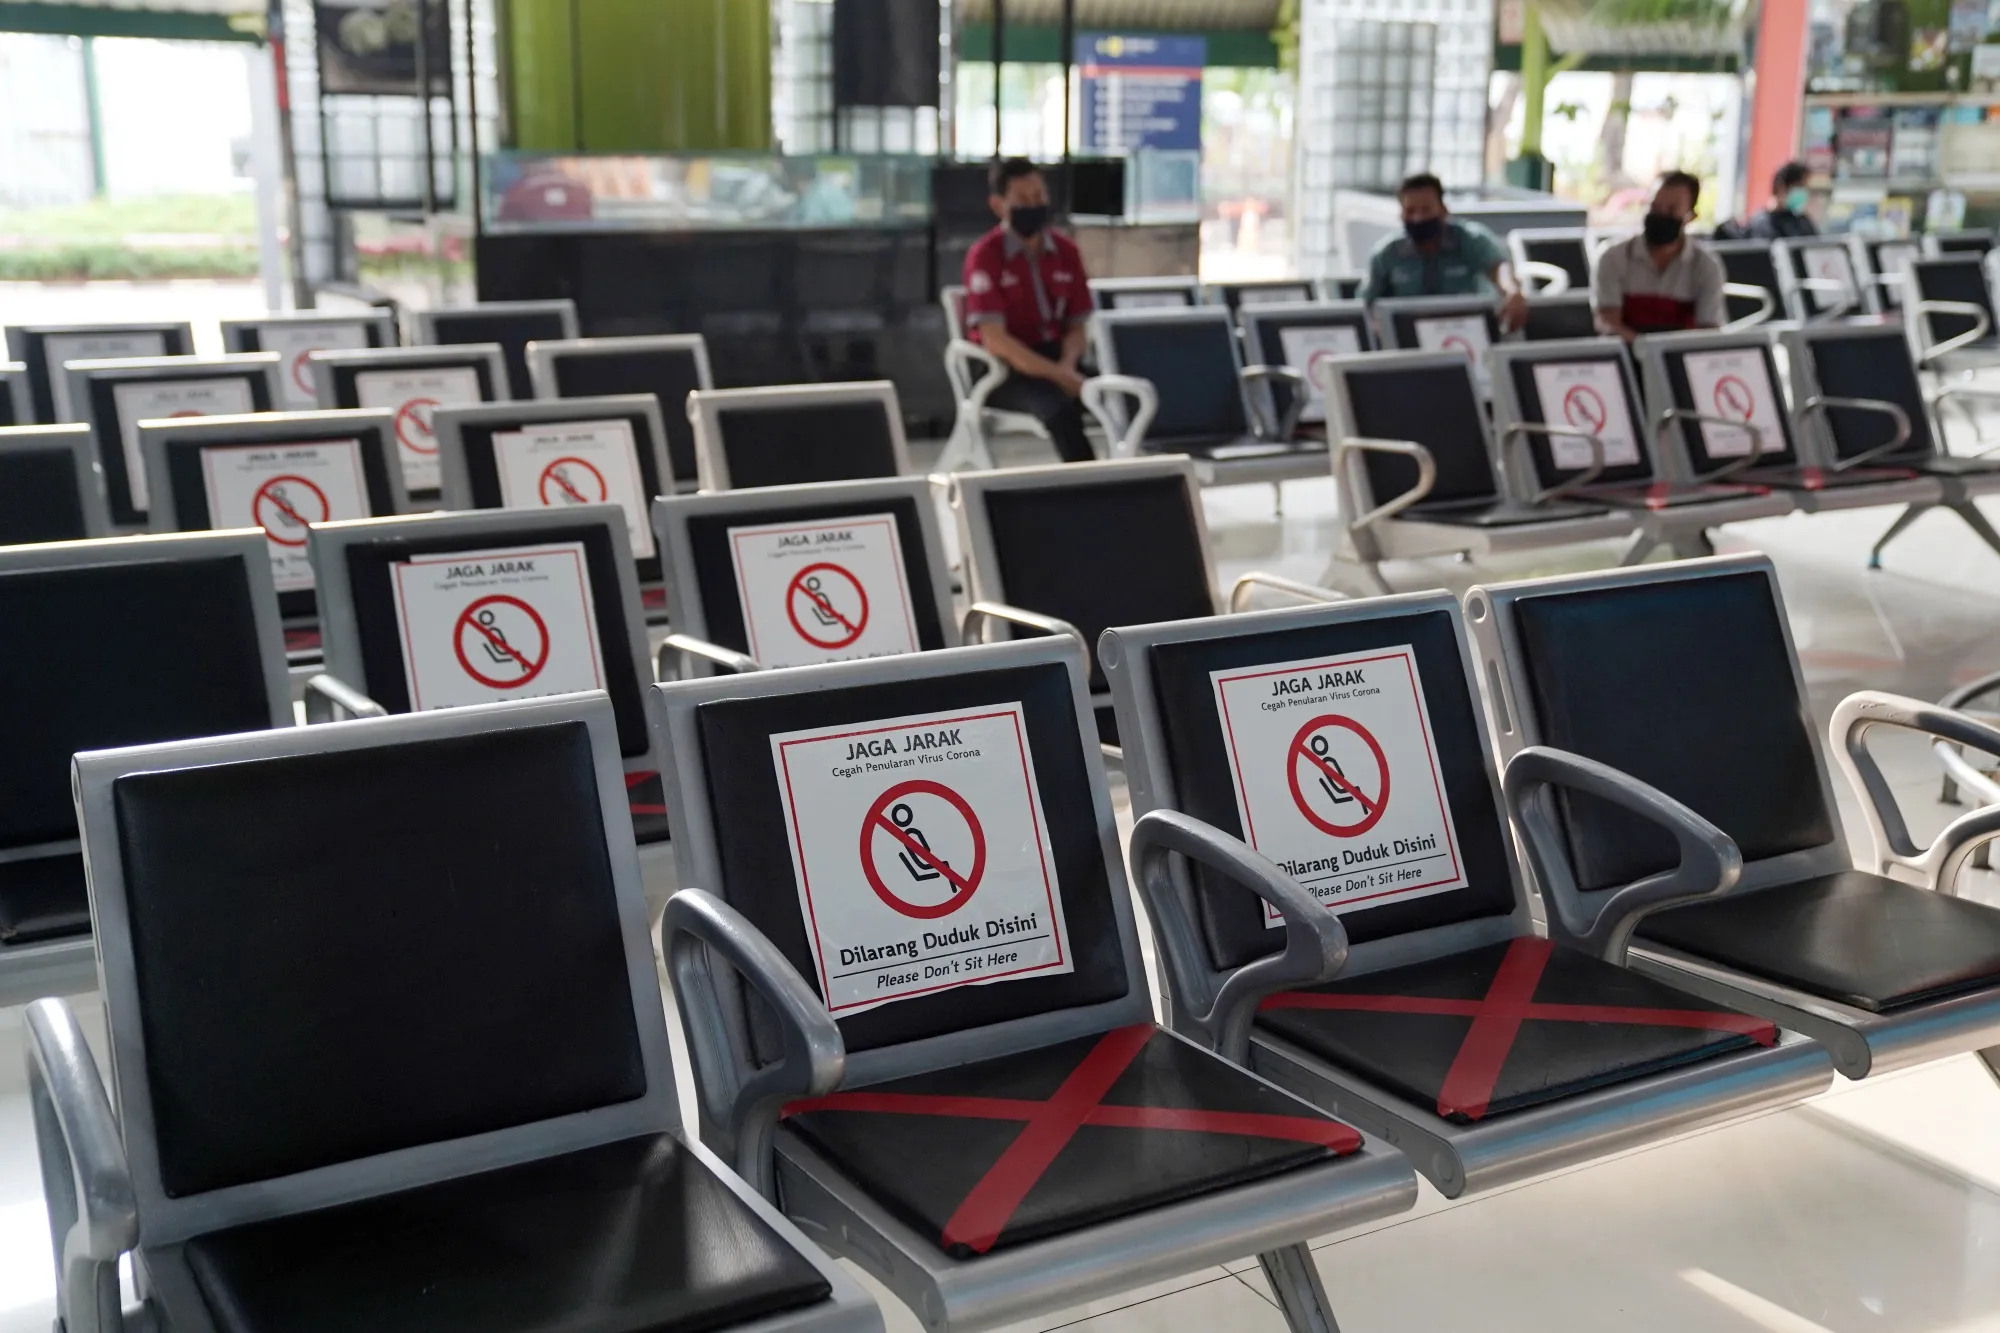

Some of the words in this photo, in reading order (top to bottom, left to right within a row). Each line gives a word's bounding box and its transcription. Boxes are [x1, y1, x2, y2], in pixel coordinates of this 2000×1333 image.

[446, 563, 485, 580] JAGA
[490, 560, 537, 576] JARAK
[1271, 677, 1313, 697] JAGA
[1317, 668, 1366, 690] JARAK
[1260, 698, 1286, 712] Cegah
[1287, 694, 1328, 707] Penularan
[1329, 691, 1351, 702] Virus
[1352, 686, 1381, 698] Corona
[845, 738, 898, 761] JAGA
[903, 728, 963, 753] JARAK
[831, 762, 863, 778] Cegah
[865, 757, 916, 773] Penularan
[917, 753, 944, 764] Virus
[945, 748, 981, 761] Corona
[1342, 842, 1390, 866] Duduk
[1393, 833, 1437, 856] Disini
[1345, 874, 1375, 892] Don't
[1378, 873, 1394, 885] Sit
[1397, 868, 1422, 882] Here
[839, 940, 919, 967] Dilarang
[922, 923, 981, 950] Duduk
[985, 912, 1038, 938] Disini
[876, 971, 920, 989] Please
[924, 960, 960, 979] Don't
[964, 956, 983, 971] Sit
[987, 952, 1018, 967] Here
